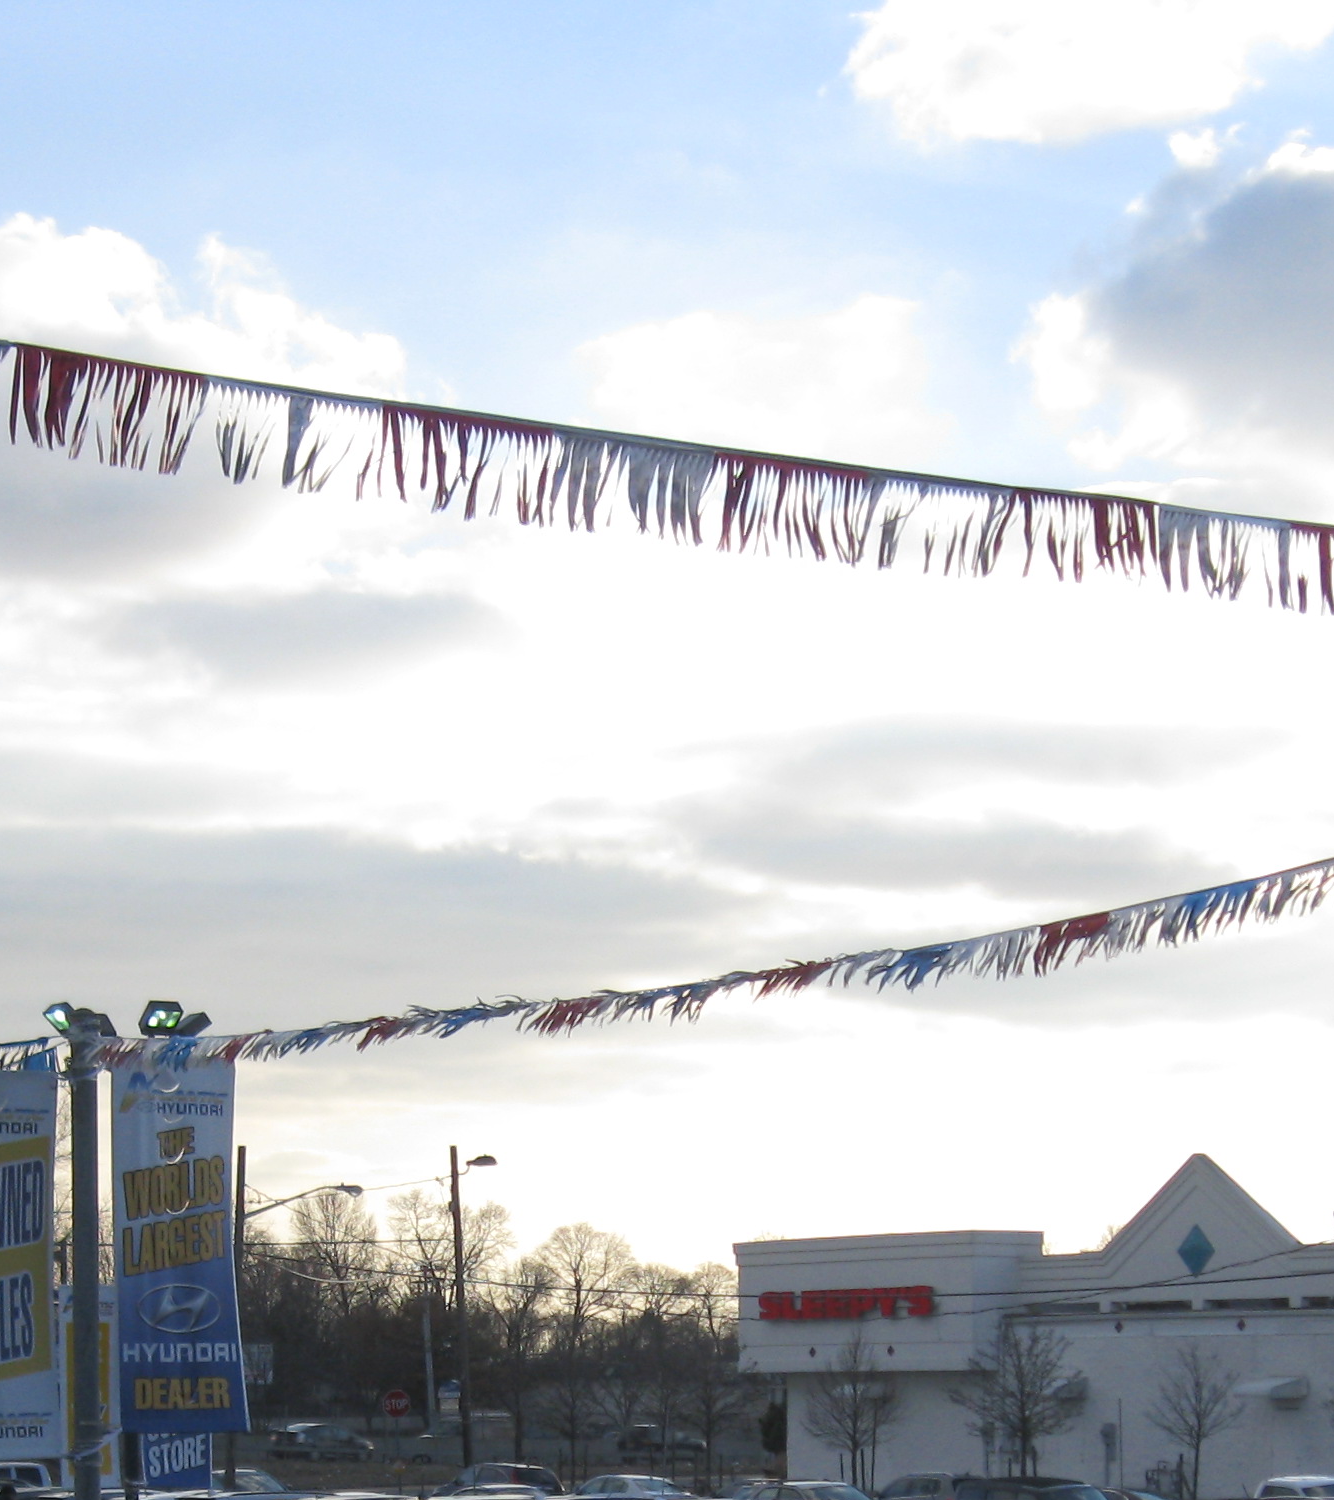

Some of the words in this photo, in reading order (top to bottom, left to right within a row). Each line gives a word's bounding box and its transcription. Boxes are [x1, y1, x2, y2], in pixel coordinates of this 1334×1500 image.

[156, 1102, 223, 1117] HYUNDAI
[157, 1126, 195, 1160] THE
[123, 1155, 225, 1221] WORLDS
[122, 1210, 227, 1278] LARGEST
[122, 1342, 238, 1363] HYUNDAI
[134, 1376, 231, 1411] DEALER
[148, 1434, 208, 1478] STORE
